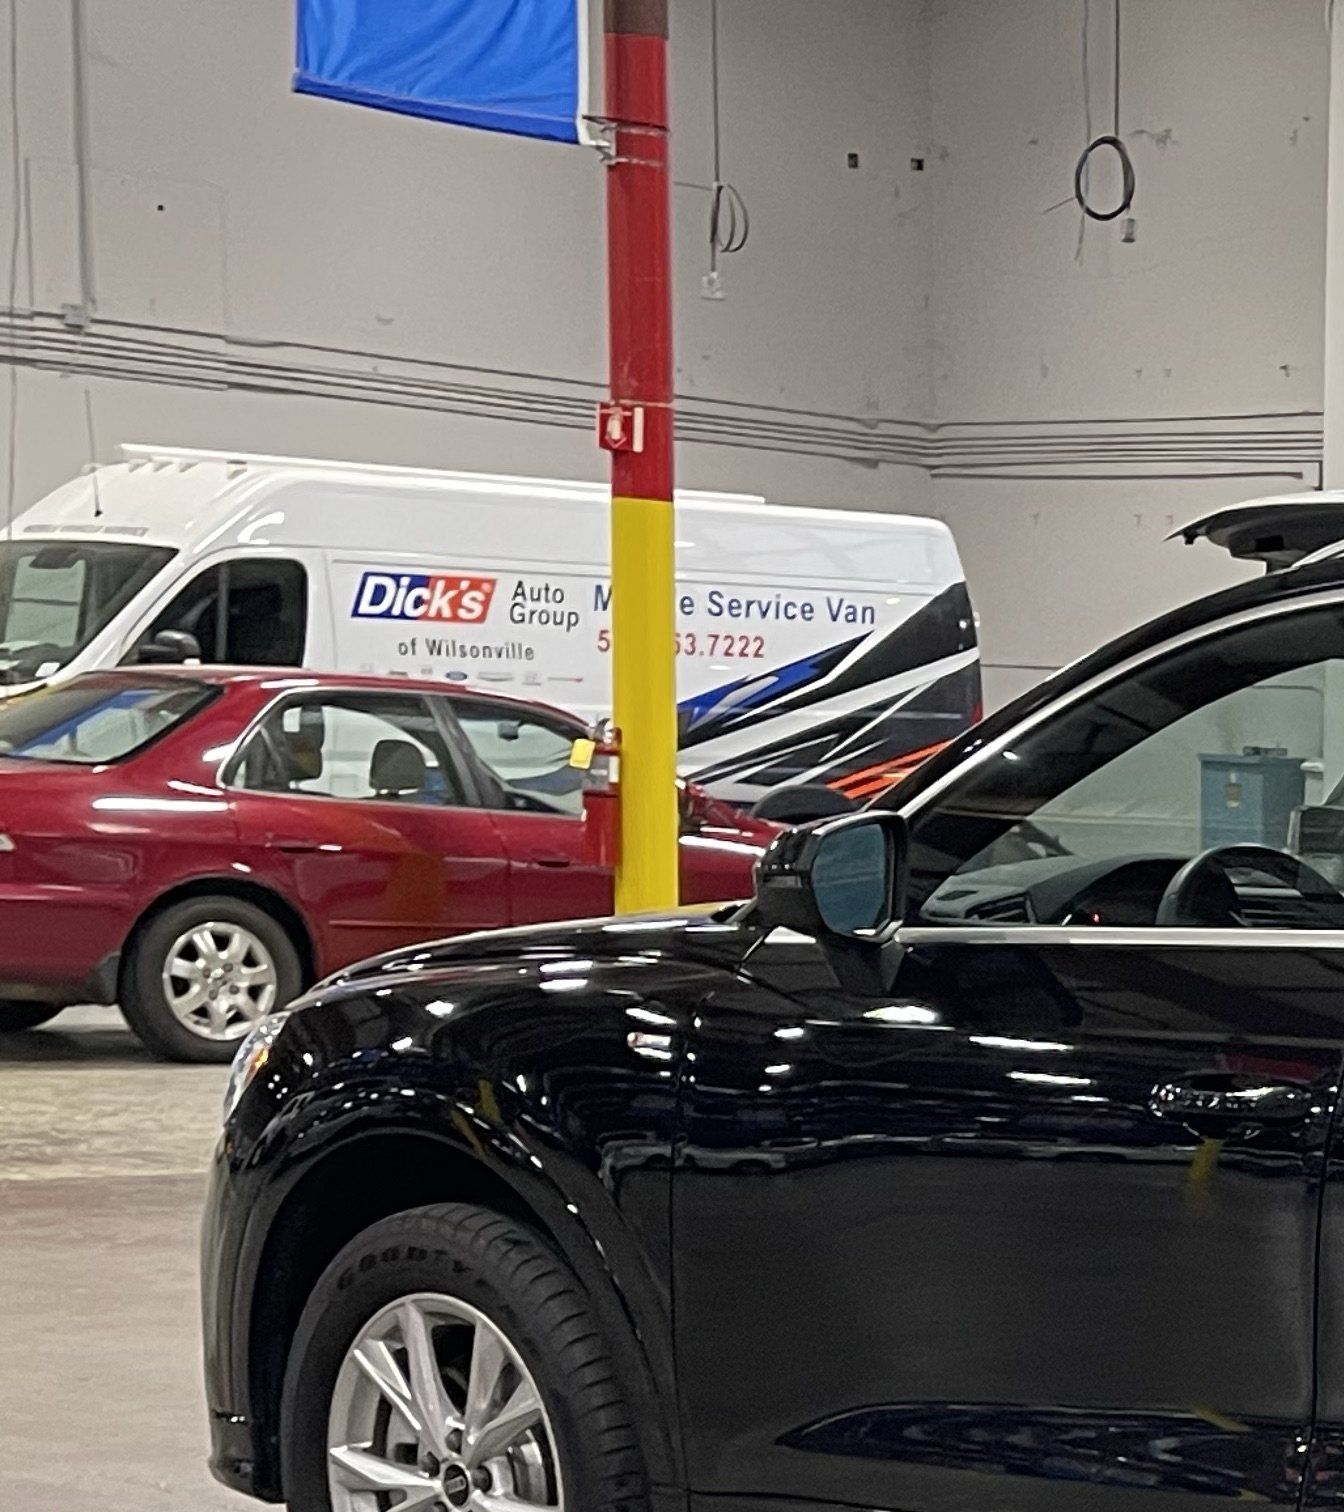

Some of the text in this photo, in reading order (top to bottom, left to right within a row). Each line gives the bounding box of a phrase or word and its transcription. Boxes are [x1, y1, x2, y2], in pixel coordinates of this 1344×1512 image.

[357, 575, 486, 620] Dick's
[511, 580, 566, 604] Auto
[509, 602, 580, 632] Group
[707, 590, 815, 622] Service
[826, 596, 876, 625] Van
[397, 637, 418, 656] of
[425, 638, 535, 661] Wilsonville
